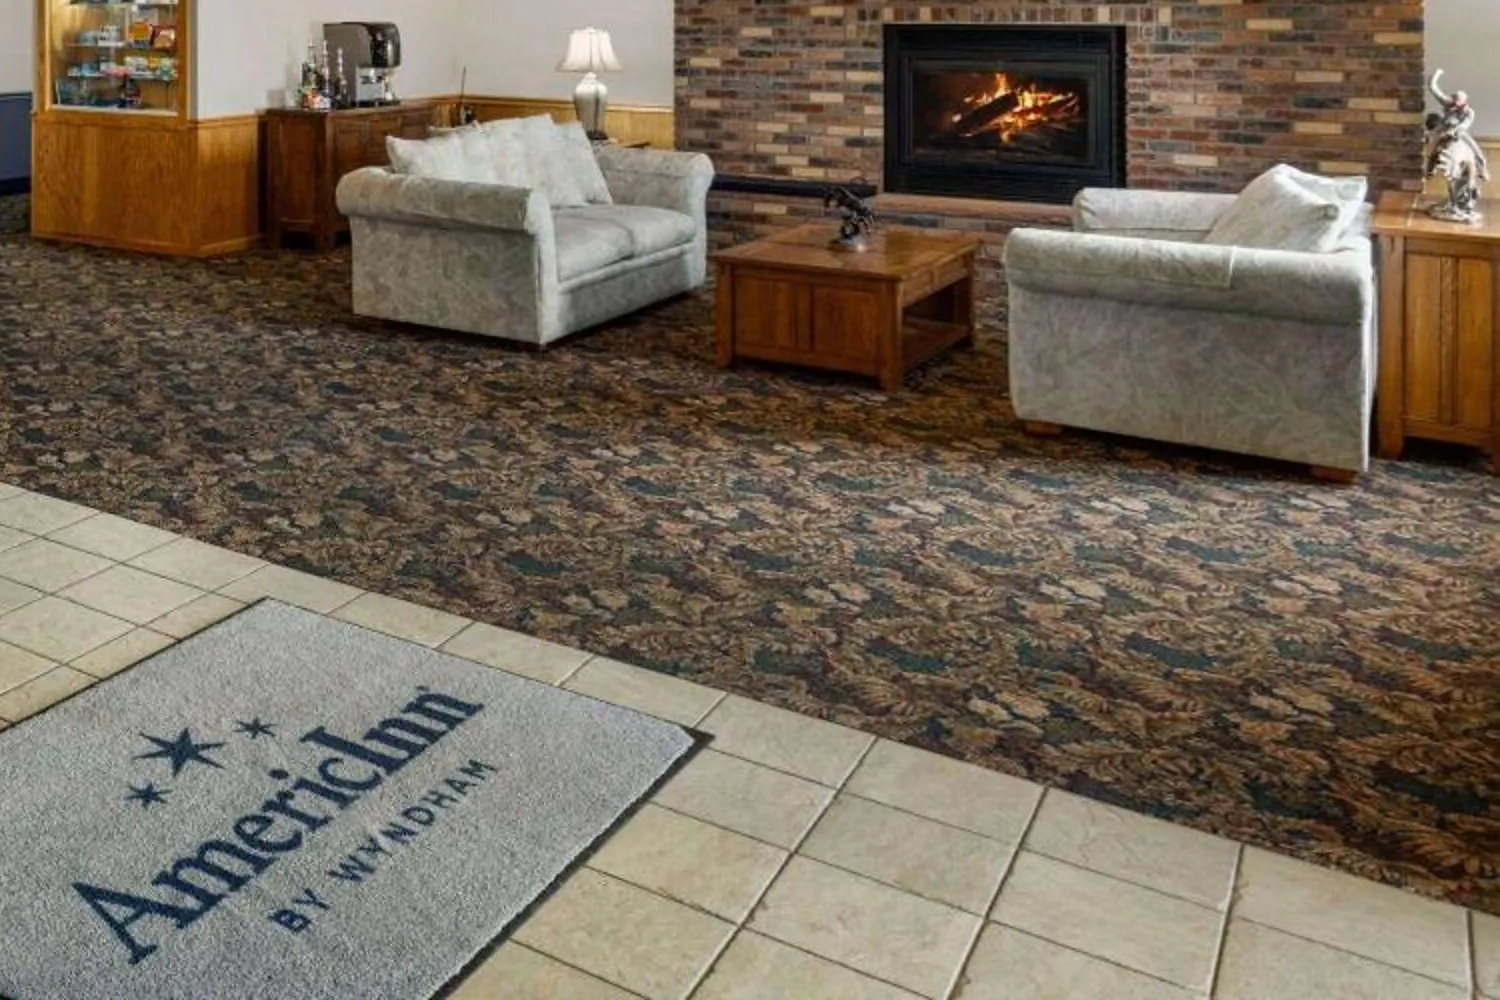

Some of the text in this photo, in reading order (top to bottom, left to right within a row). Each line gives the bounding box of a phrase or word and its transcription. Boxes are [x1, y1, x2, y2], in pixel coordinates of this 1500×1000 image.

[72, 690, 485, 965] AmericInn
[268, 758, 498, 934] BY WYNDHAM
